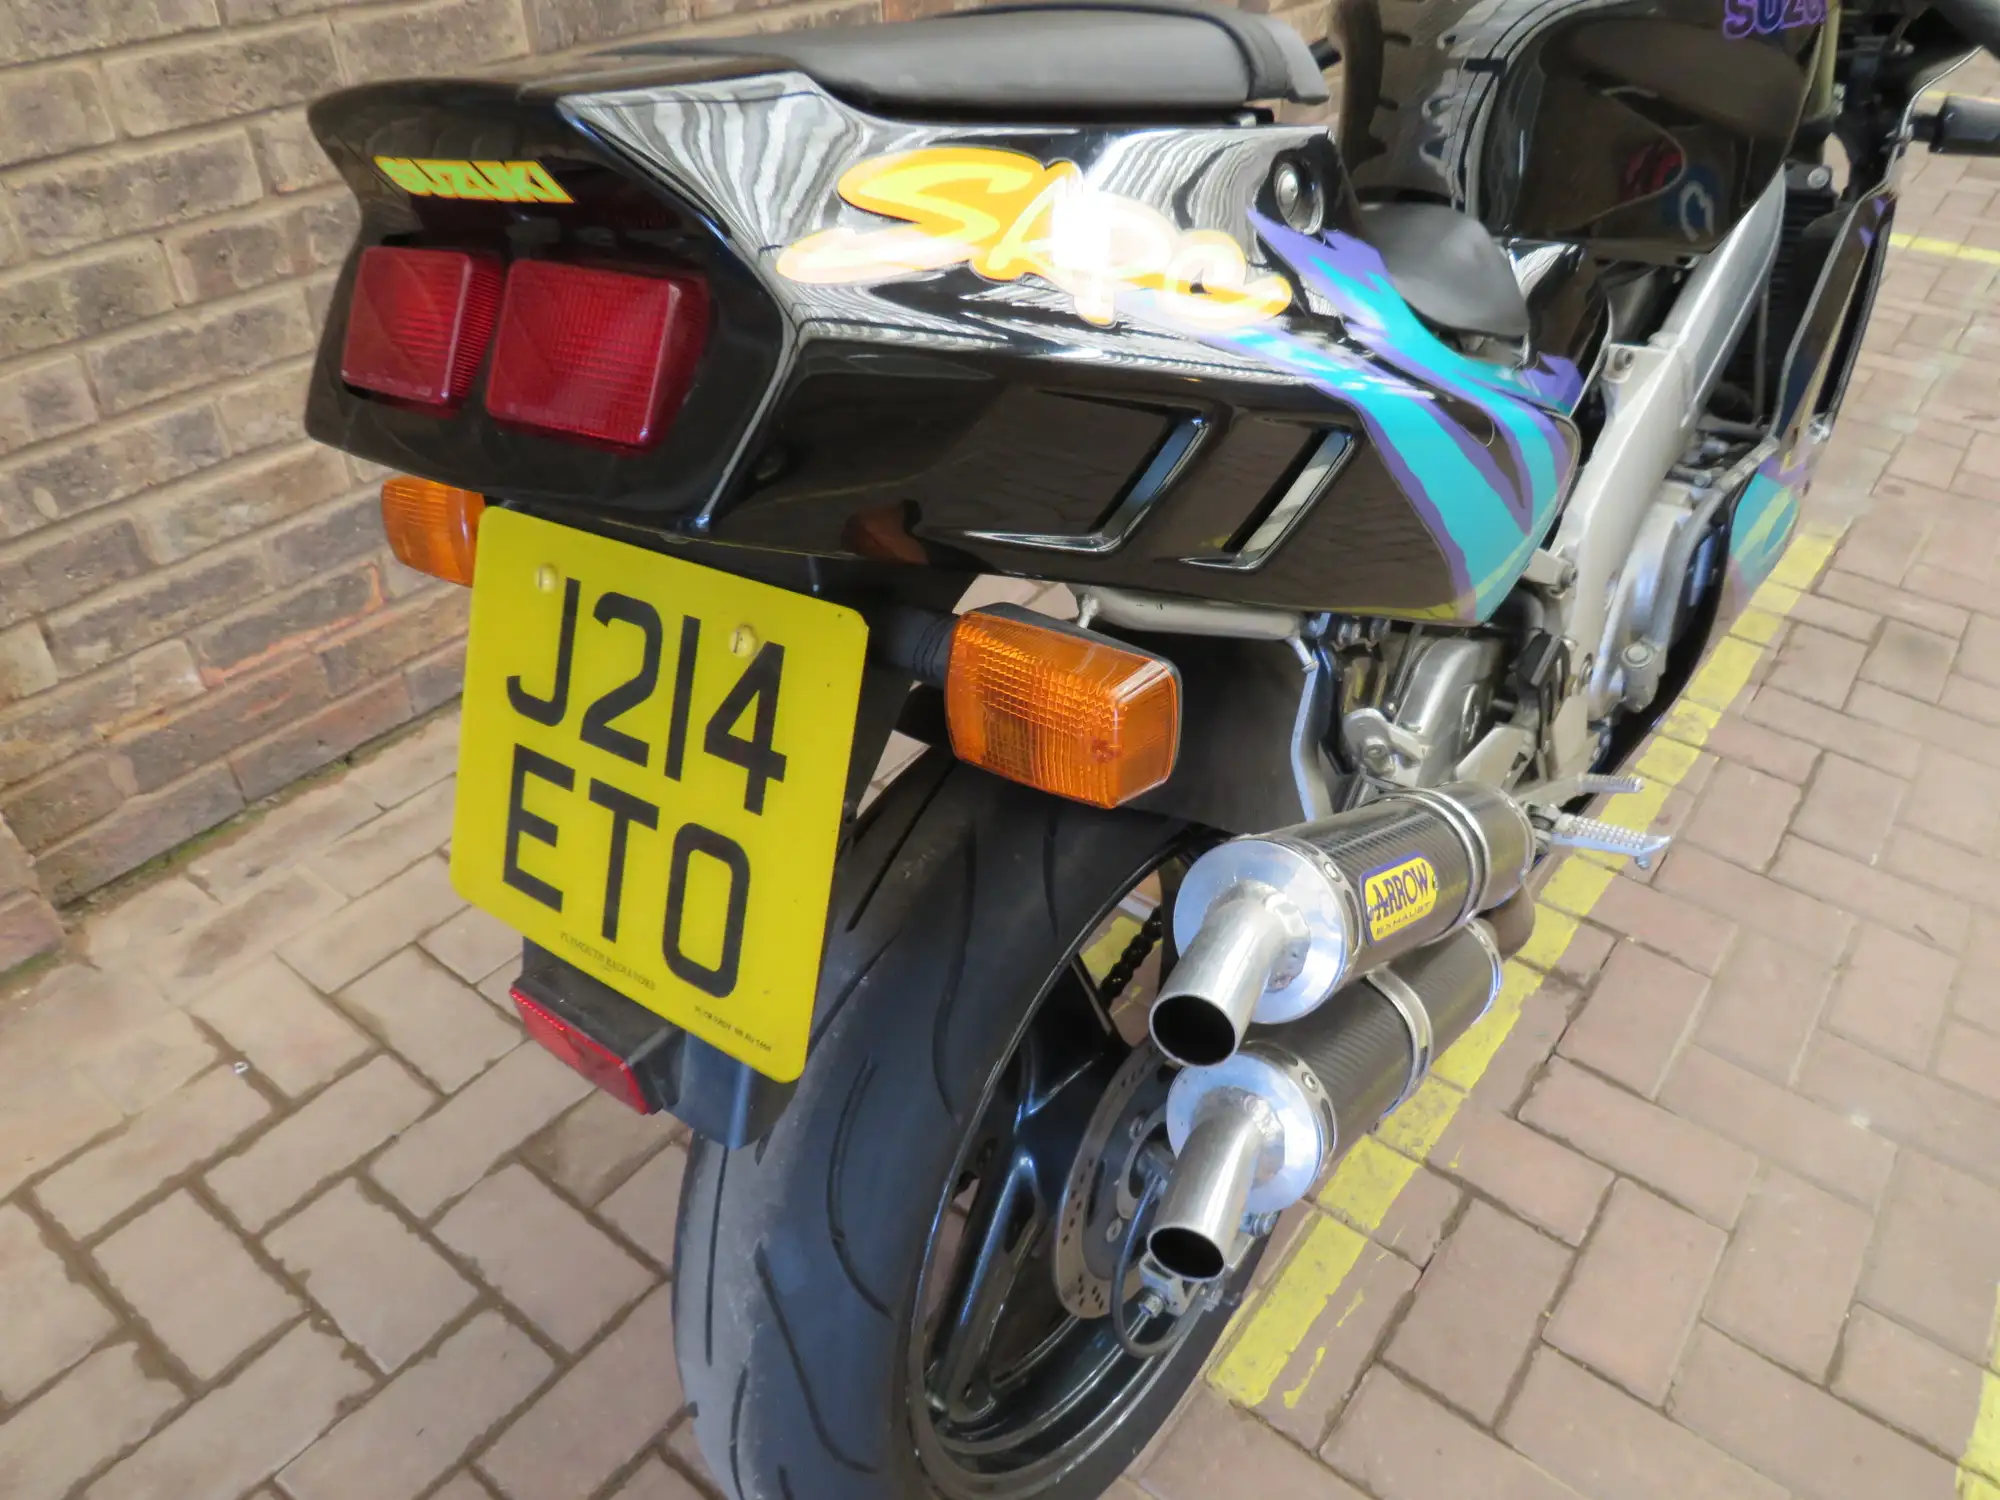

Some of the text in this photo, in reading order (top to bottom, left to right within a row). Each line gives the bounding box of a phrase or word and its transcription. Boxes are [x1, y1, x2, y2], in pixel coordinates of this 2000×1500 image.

[373, 156, 575, 203] SUZUKI
[506, 577, 787, 816] J214
[502, 743, 751, 998] ETO
[1369, 862, 1429, 921] ARROW
